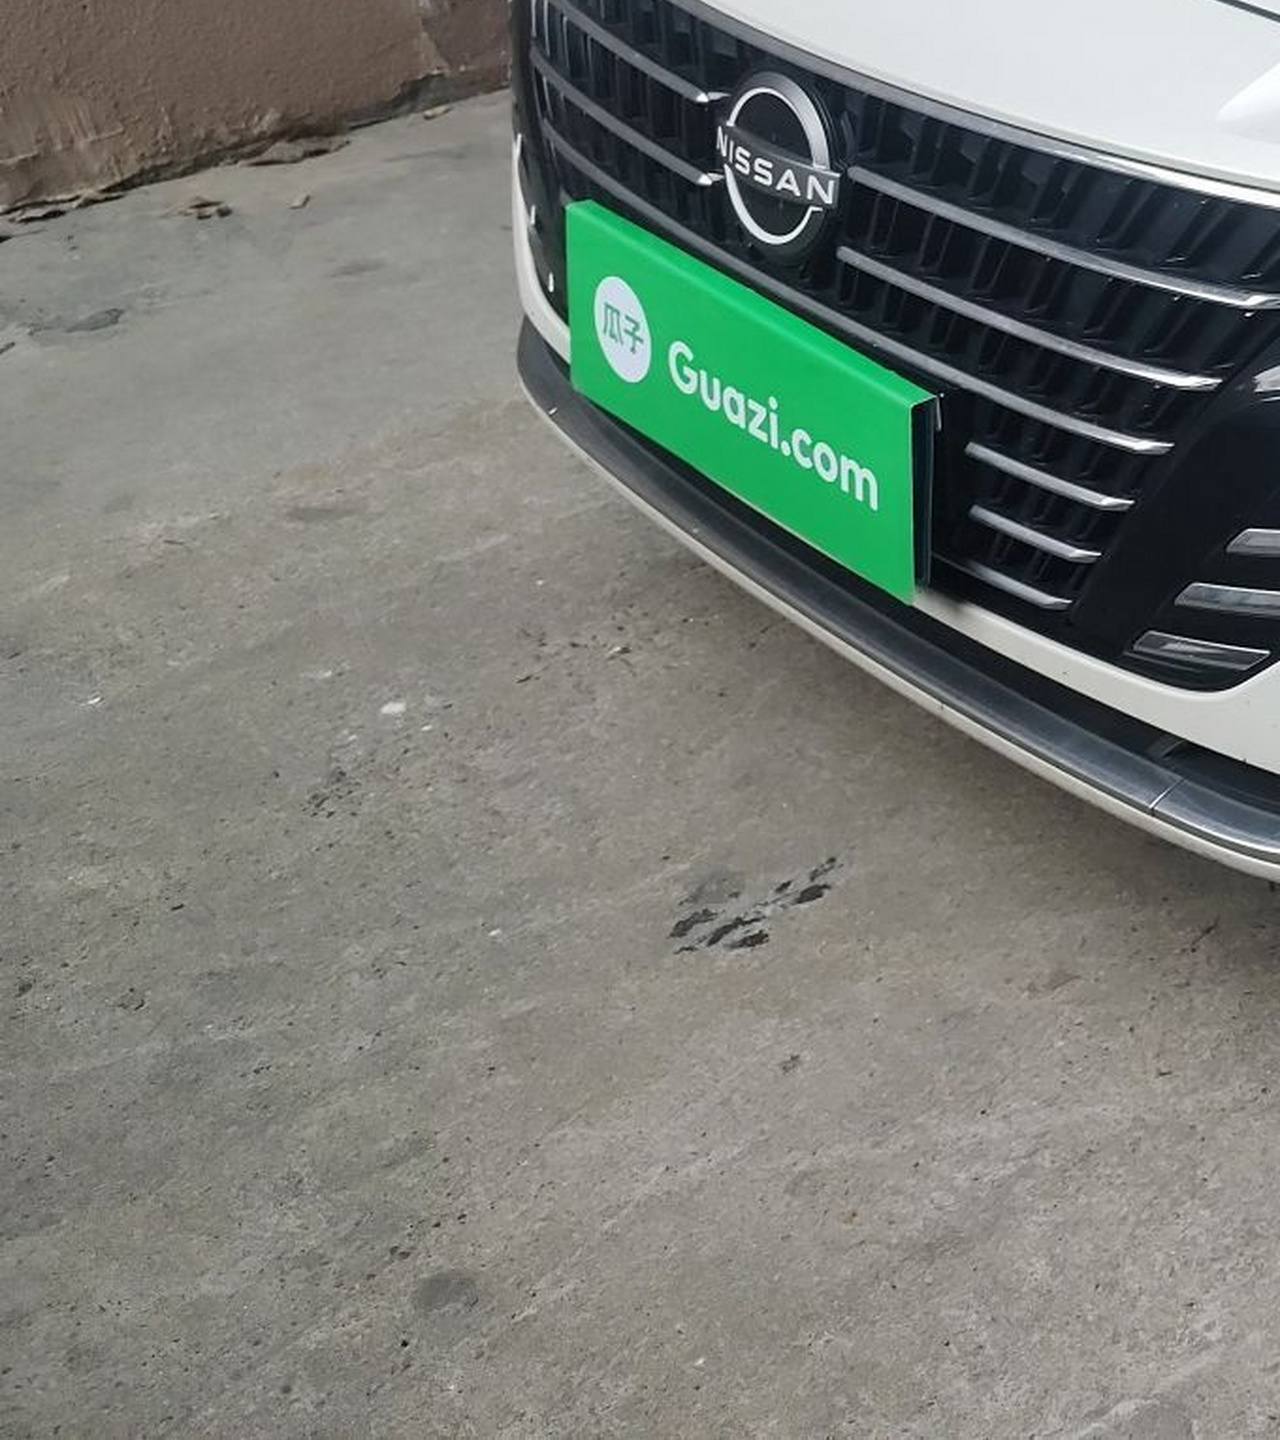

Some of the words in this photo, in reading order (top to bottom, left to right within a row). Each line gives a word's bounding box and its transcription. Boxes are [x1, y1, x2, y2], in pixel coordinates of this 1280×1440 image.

[716, 125, 835, 205] NISSAN
[603, 303, 645, 355] 瓜子
[667, 341, 879, 512] Guazi.com
